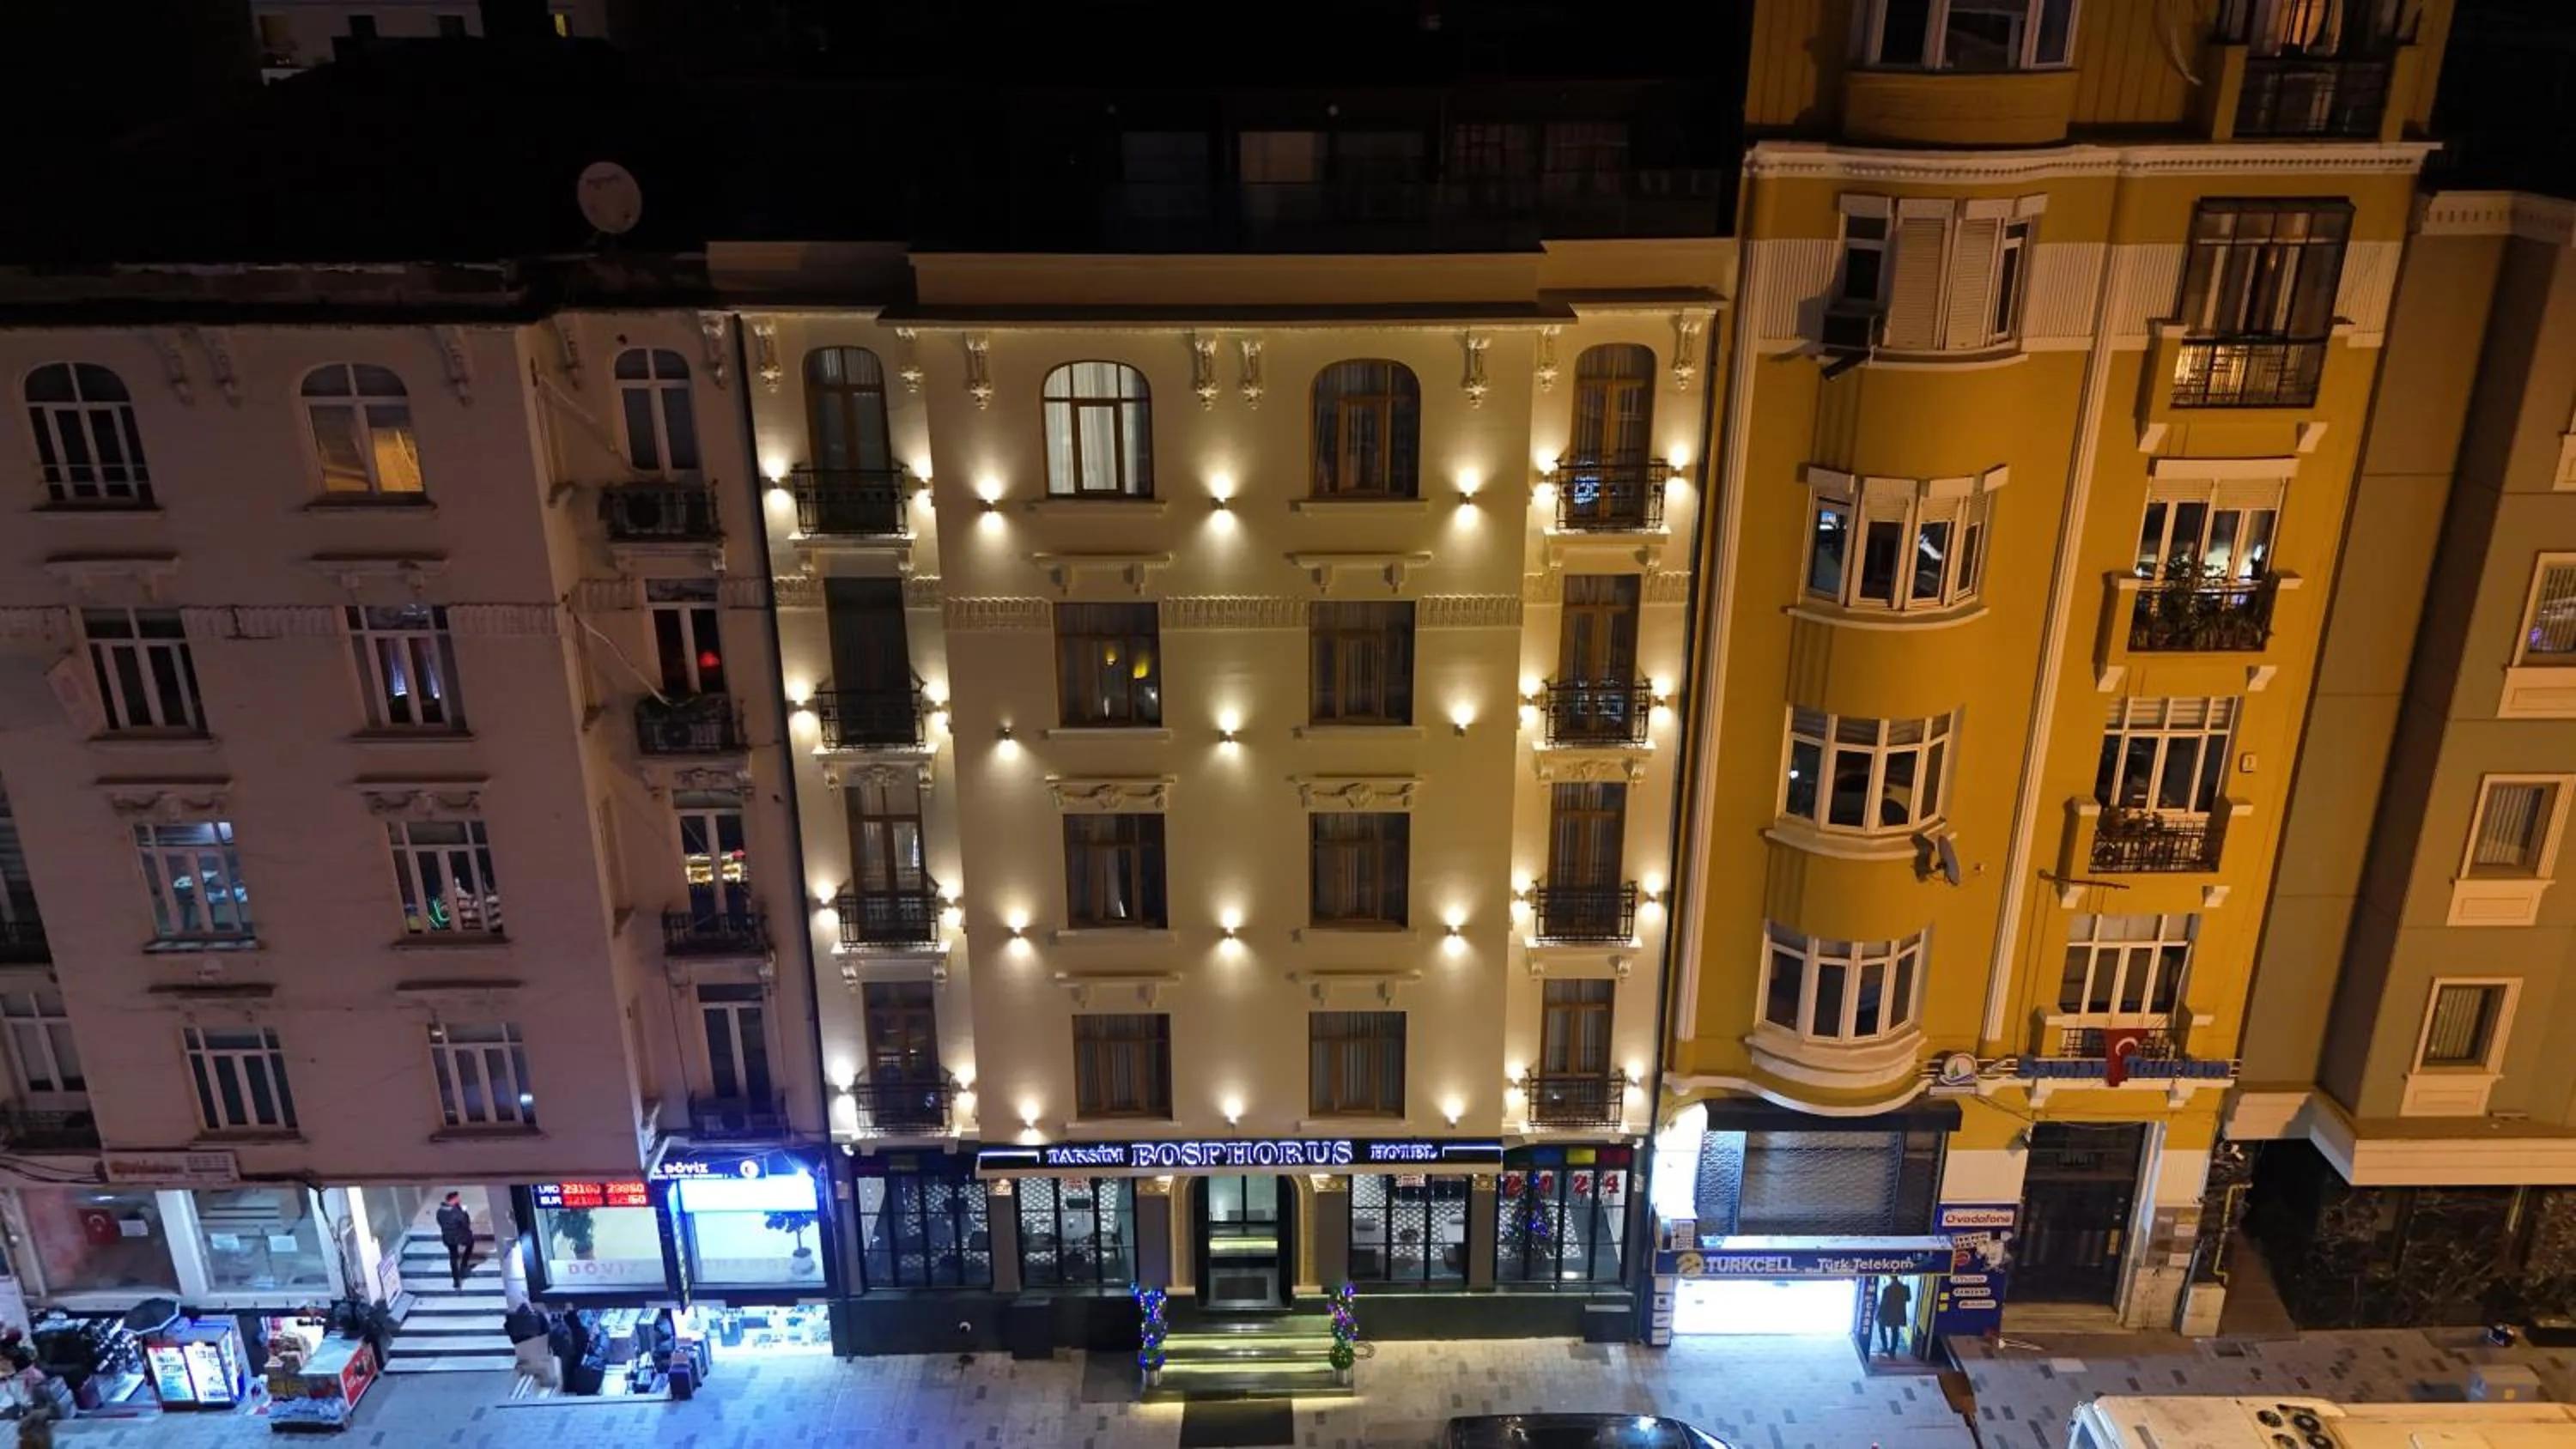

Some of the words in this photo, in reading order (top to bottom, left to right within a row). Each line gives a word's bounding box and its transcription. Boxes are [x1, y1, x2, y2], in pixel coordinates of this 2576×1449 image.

[1131, 1141, 1353, 1167] BOSPHORUS
[1370, 1144, 1438, 1160] HOTEL
[540, 1196, 562, 1205] EUR
[1959, 1214, 2012, 1224] vodafone
[1852, 1257, 1915, 1271] Telekom
